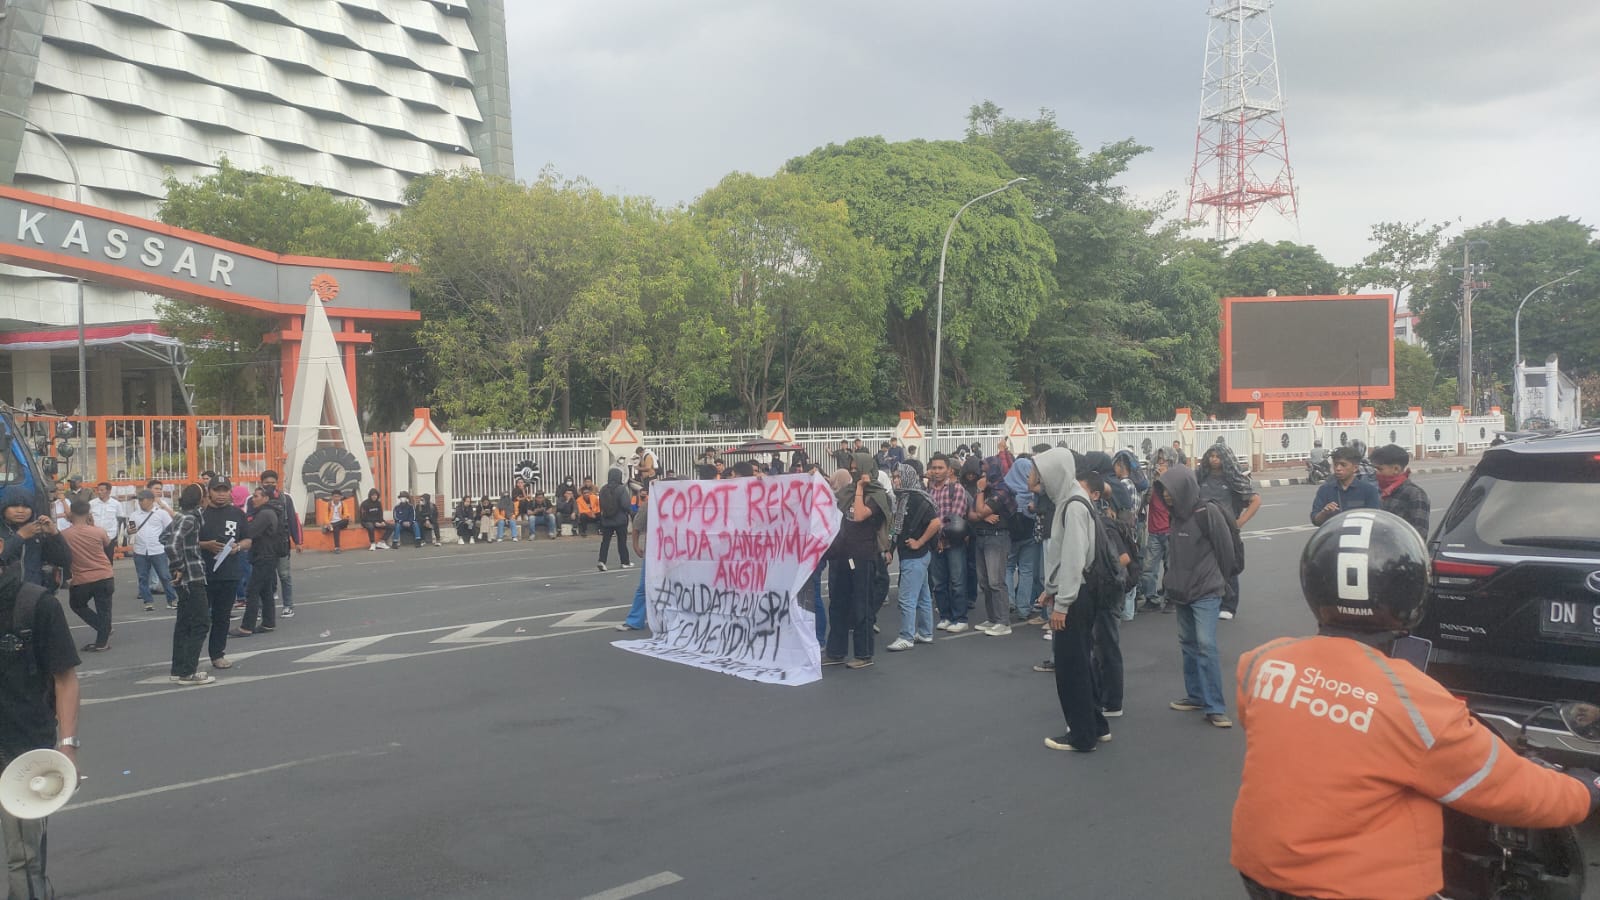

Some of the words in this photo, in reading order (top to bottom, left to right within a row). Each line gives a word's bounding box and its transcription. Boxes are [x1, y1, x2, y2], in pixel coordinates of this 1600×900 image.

[17, 208, 235, 287] KASSAR
[657, 484, 738, 526] COPOT
[746, 480, 833, 535] REKTOR
[656, 527, 713, 561] POLDA
[718, 528, 784, 561] JANGAN
[713, 559, 768, 591] ANGIN
[1337, 606, 1374, 616] YAMAHA
[1551, 602, 1576, 623] DN
[1440, 622, 1487, 635] INNOVA
[1300, 667, 1379, 705] Shopee
[1290, 685, 1375, 734] Food
